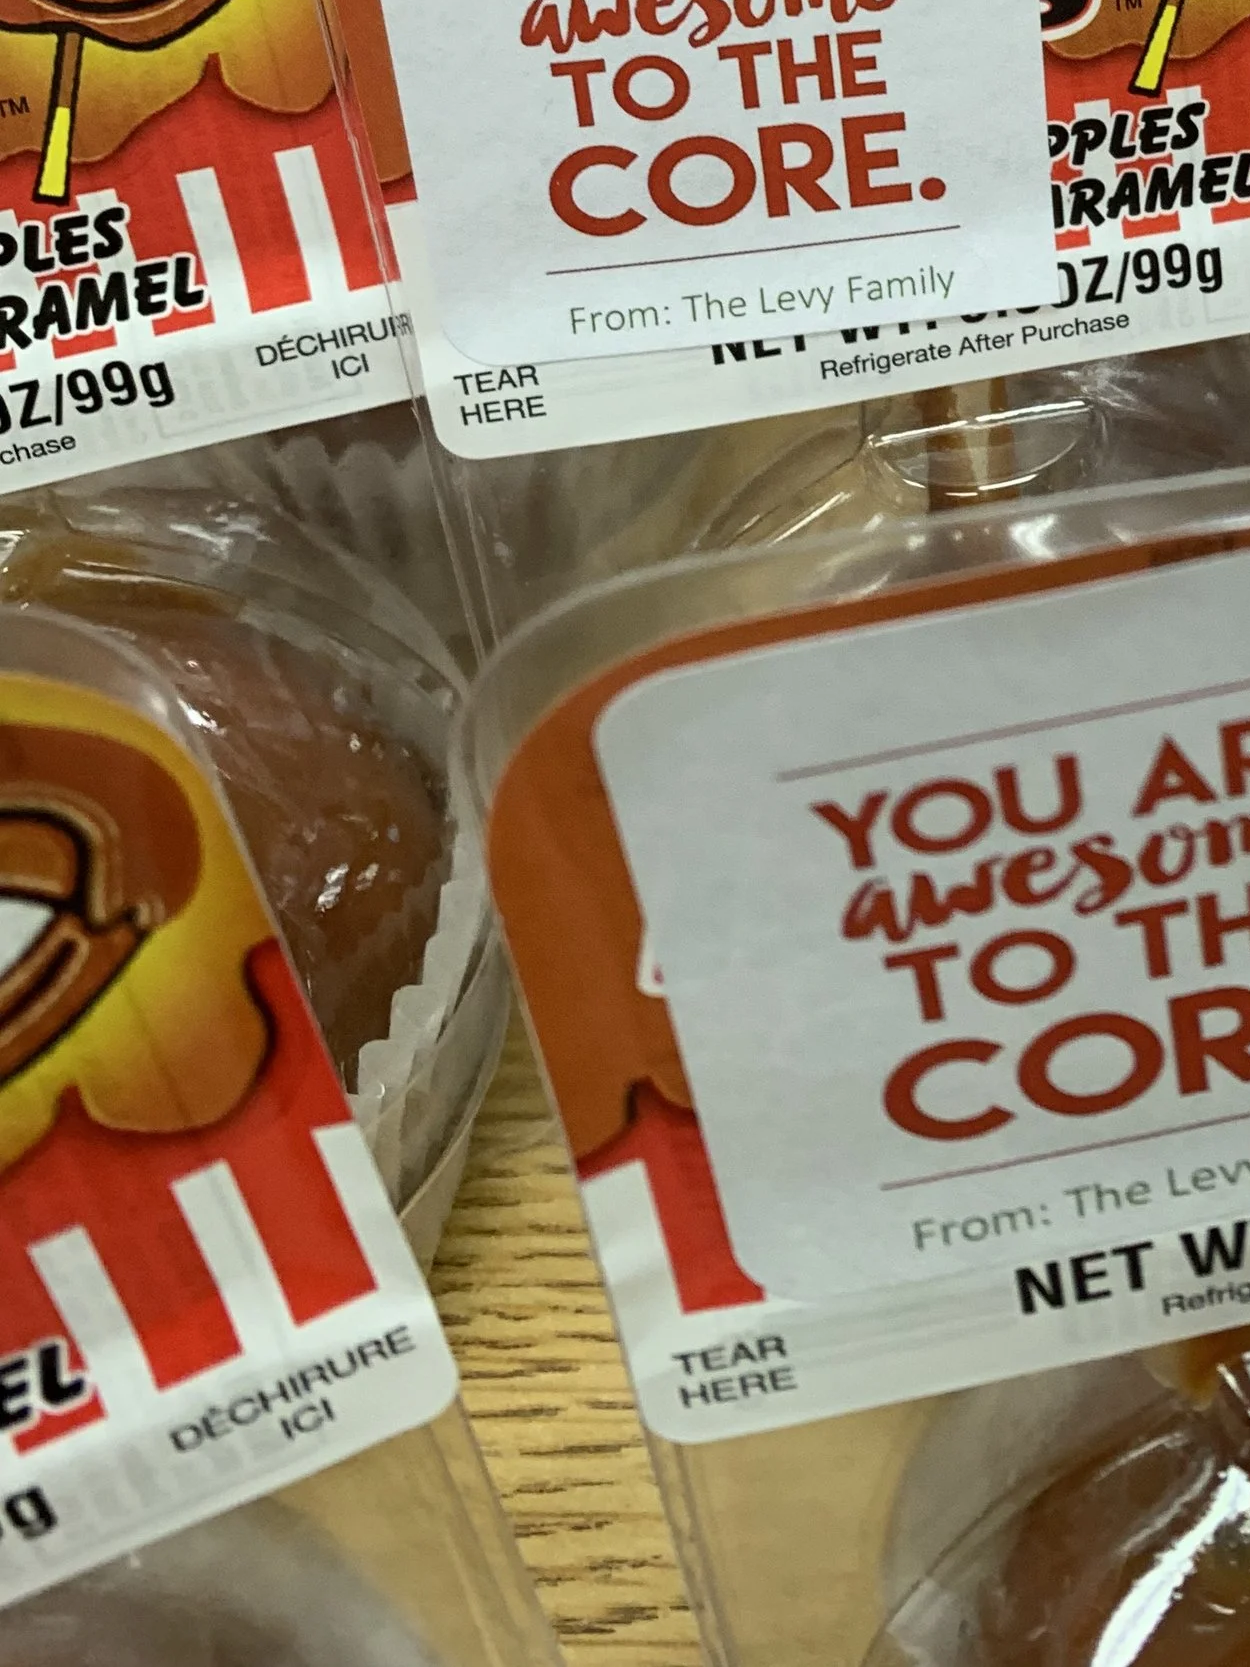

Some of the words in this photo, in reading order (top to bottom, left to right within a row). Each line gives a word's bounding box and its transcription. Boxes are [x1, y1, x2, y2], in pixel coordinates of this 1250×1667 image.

[549, 54, 691, 128] TO
[717, 29, 888, 110] THE
[548, 111, 947, 238] CORE.
[569, 299, 672, 336] From:
[681, 290, 748, 324] The
[759, 281, 835, 318] Levy
[846, 265, 956, 306] Family
[331, 353, 370, 380] ICI
[453, 364, 540, 398] TEAR
[819, 340, 952, 381] Refrigerate
[958, 329, 1014, 358] After
[1021, 311, 1131, 347] Purchase
[460, 395, 548, 428] HERE
[809, 752, 1085, 871] YOU
[882, 928, 1078, 1024] TO
[911, 1202, 1052, 1251] From:
[1063, 1177, 1152, 1223] The
[1013, 1240, 1155, 1316] NET
[167, 1323, 417, 1455] DÉCHIRURE
[673, 1336, 788, 1379] TEAR
[678, 1366, 798, 1412] HERE
[281, 1400, 337, 1443] ICI
